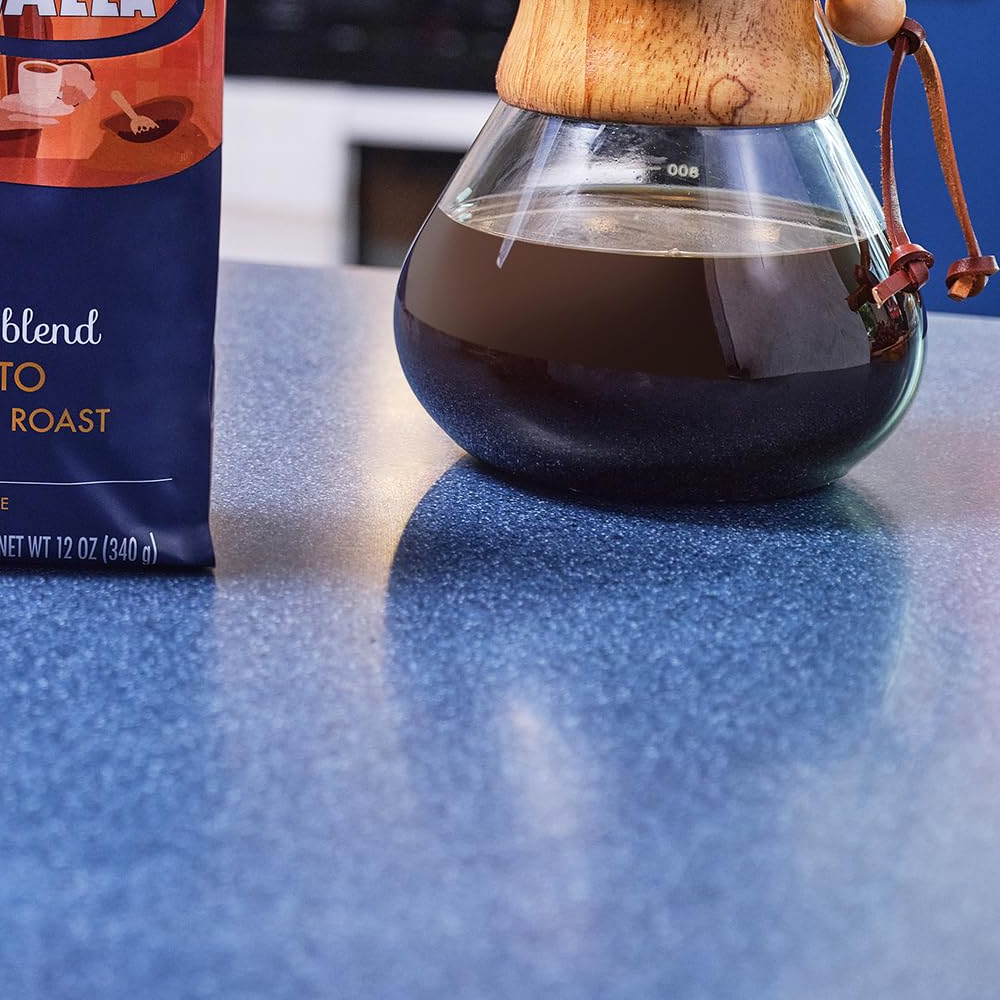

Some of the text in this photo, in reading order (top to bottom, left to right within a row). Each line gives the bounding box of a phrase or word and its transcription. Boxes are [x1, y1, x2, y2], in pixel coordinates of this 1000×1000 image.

[1, 307, 102, 345] blend
[11, 407, 111, 434] ROAST
[28, 535, 51, 559] WT
[56, 536, 73, 560] 12
[78, 537, 97, 561] OZ
[102, 534, 138, 564] (340
[142, 532, 158, 565] g)
